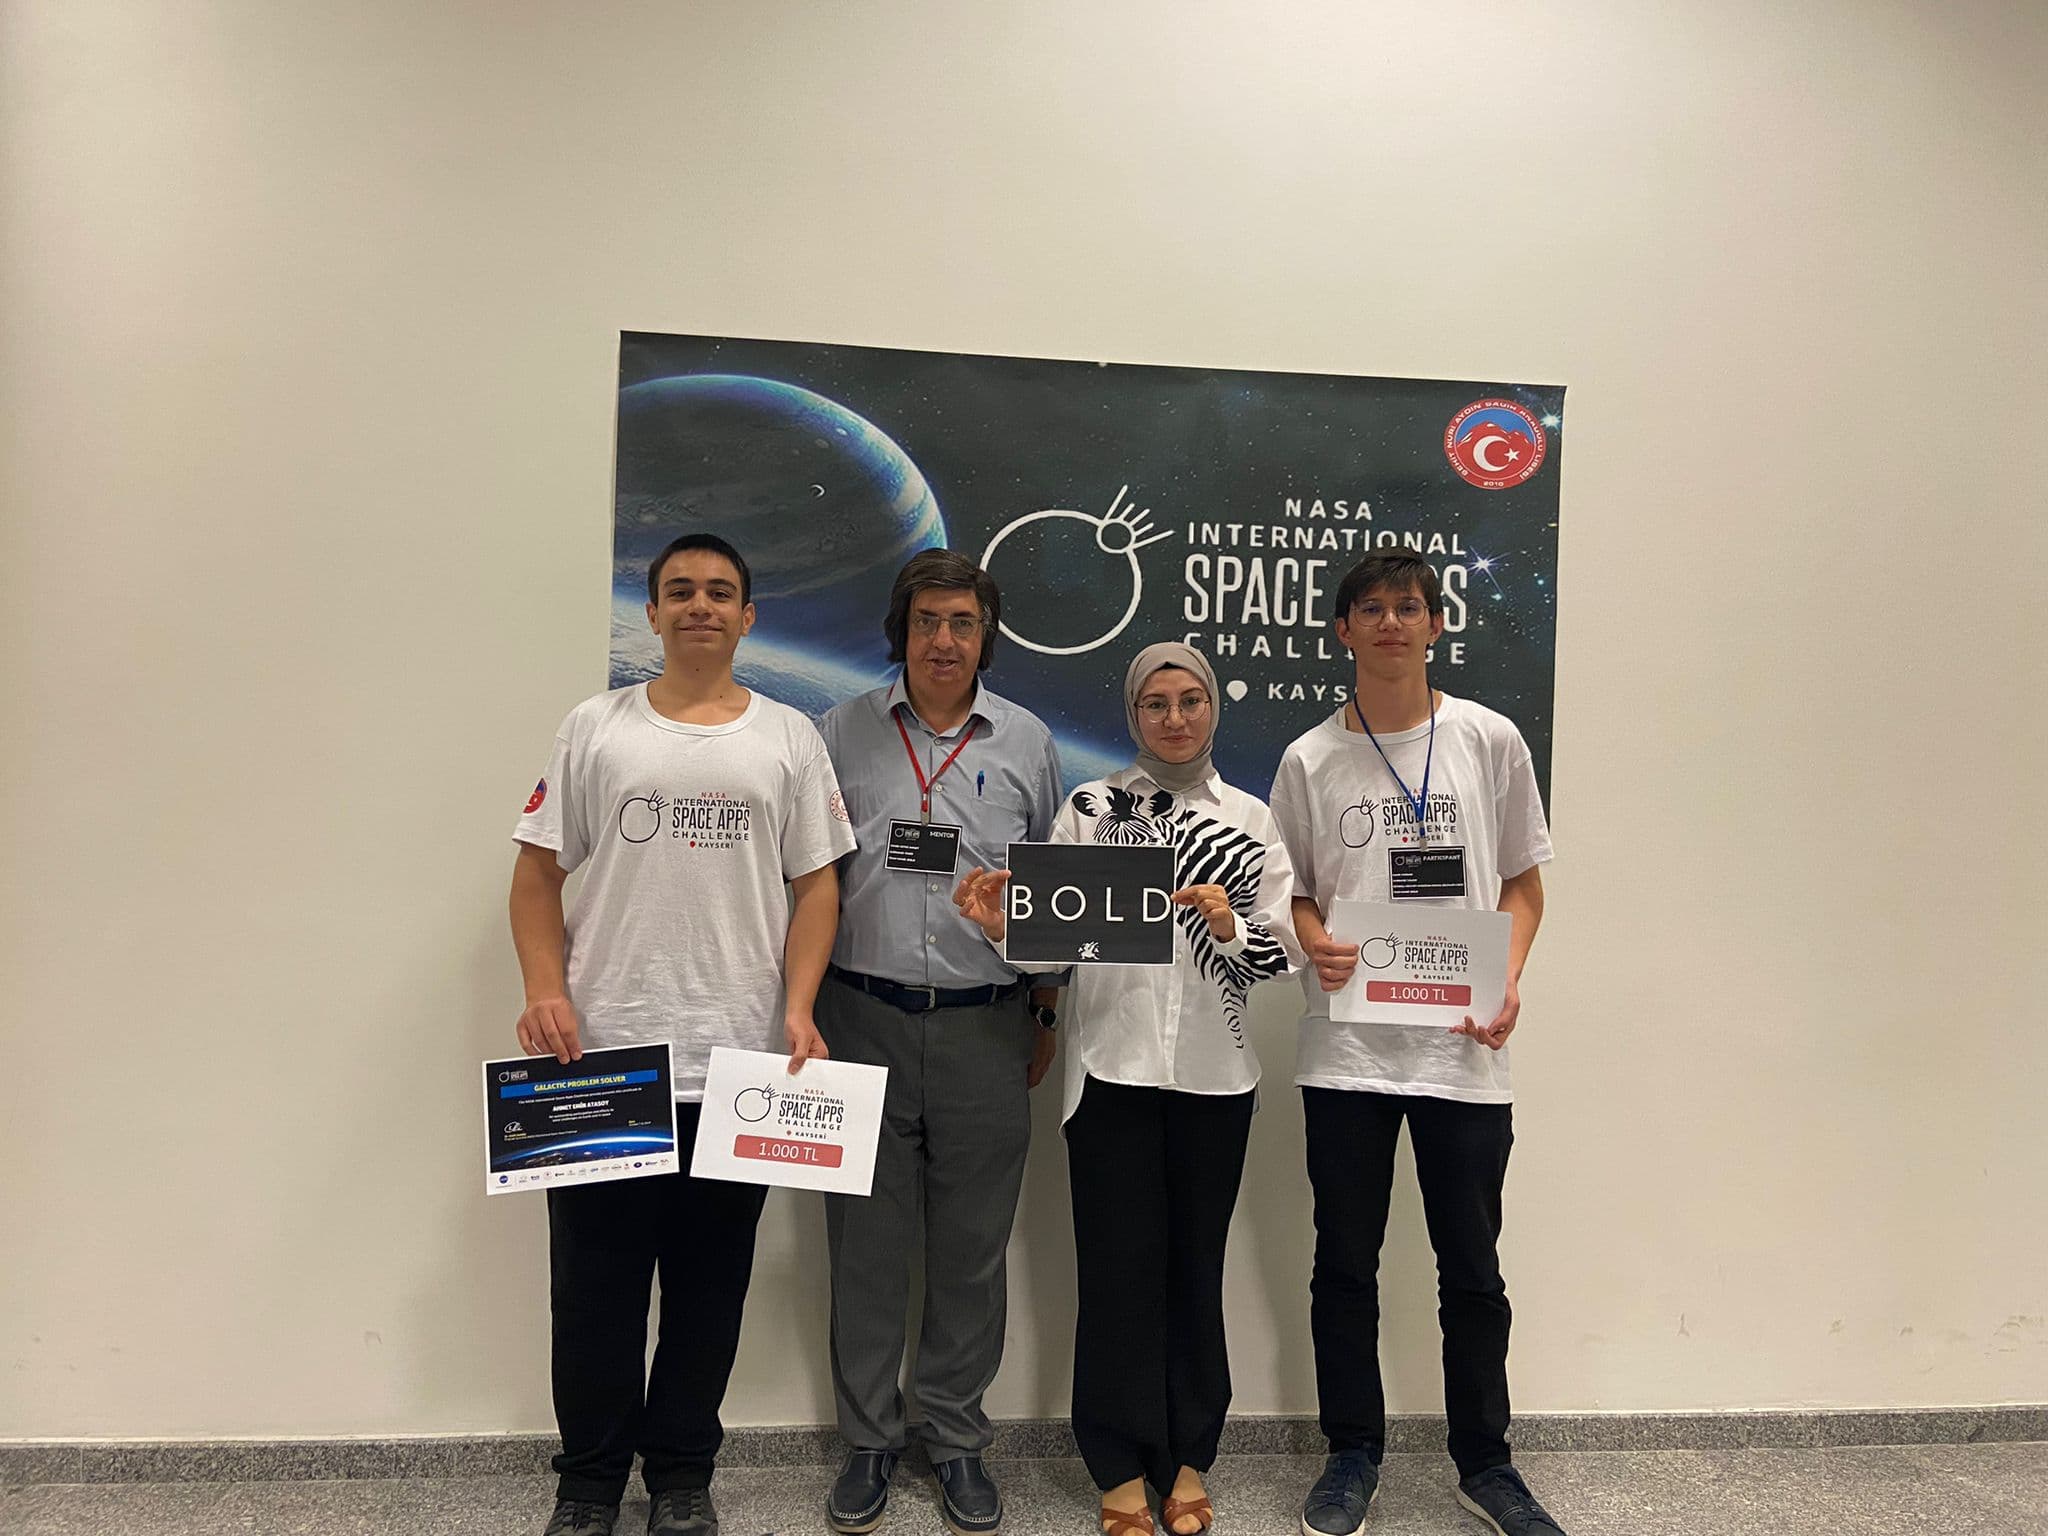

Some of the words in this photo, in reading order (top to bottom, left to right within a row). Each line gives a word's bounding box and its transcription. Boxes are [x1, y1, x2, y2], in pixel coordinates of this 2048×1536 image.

[1285, 498, 1373, 521] NASA
[1188, 521, 1467, 556] INTERNATIONAL
[1184, 553, 1327, 628] SPACE
[673, 798, 751, 809] INTERNATIONAL
[672, 806, 713, 830] SPACE
[717, 808, 750, 831] APPS
[1426, 802, 1456, 824] APPS
[672, 830, 749, 841] CHALLENGE
[930, 831, 955, 840] MENTOR
[1384, 824, 1456, 836] CHALENGE
[1011, 885, 1172, 923] BOLD
[1405, 940, 1468, 950] INTERNATIONAL
[1404, 946, 1437, 964] SPACE
[1440, 949, 1468, 966] APPS
[1404, 964, 1467, 972] CHALLENGE
[1390, 986, 1429, 1001] 1.000
[1432, 988, 1448, 1002] TL
[534, 1082, 567, 1092] GALACTIC
[568, 1078, 600, 1088] PROBLEM
[600, 1075, 626, 1084] SOLVER
[782, 1092, 844, 1106] INTERNATIONAL
[804, 1088, 824, 1096] NASA
[779, 1100, 813, 1120] SPACE
[814, 1104, 844, 1124] APPS
[778, 1118, 841, 1131] CHALLENGE
[758, 1142, 800, 1159] 1.000
[803, 1146, 820, 1162] TL
